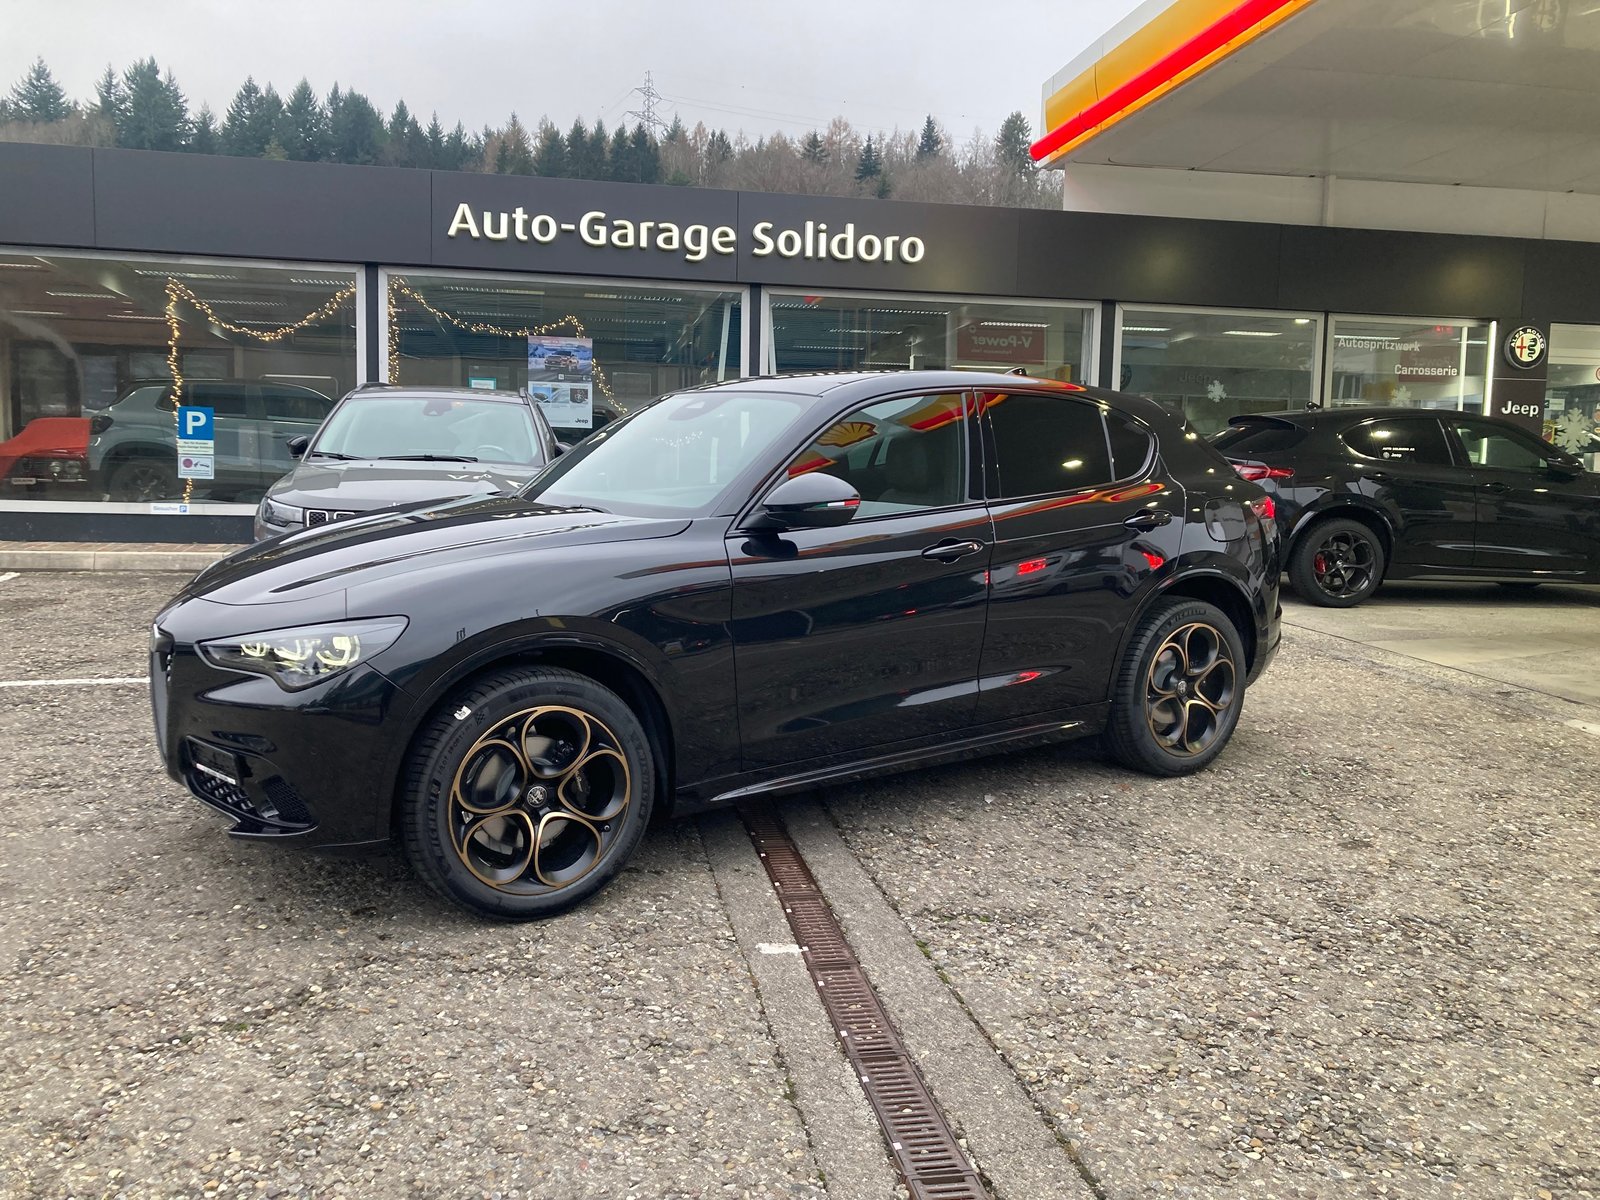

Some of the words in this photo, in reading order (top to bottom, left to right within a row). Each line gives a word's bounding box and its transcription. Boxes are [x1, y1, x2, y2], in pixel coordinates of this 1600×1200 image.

[447, 202, 737, 263] Auto-Garage
[752, 220, 926, 265] Solidoro
[1338, 337, 1421, 352] Autospritzwerk
[1510, 329, 1525, 348] ALFA
[1526, 328, 1546, 350] ROMEO
[1394, 364, 1458, 376] Carrosserie
[1501, 400, 1539, 418] Jeep
[186, 411, 207, 435] P
